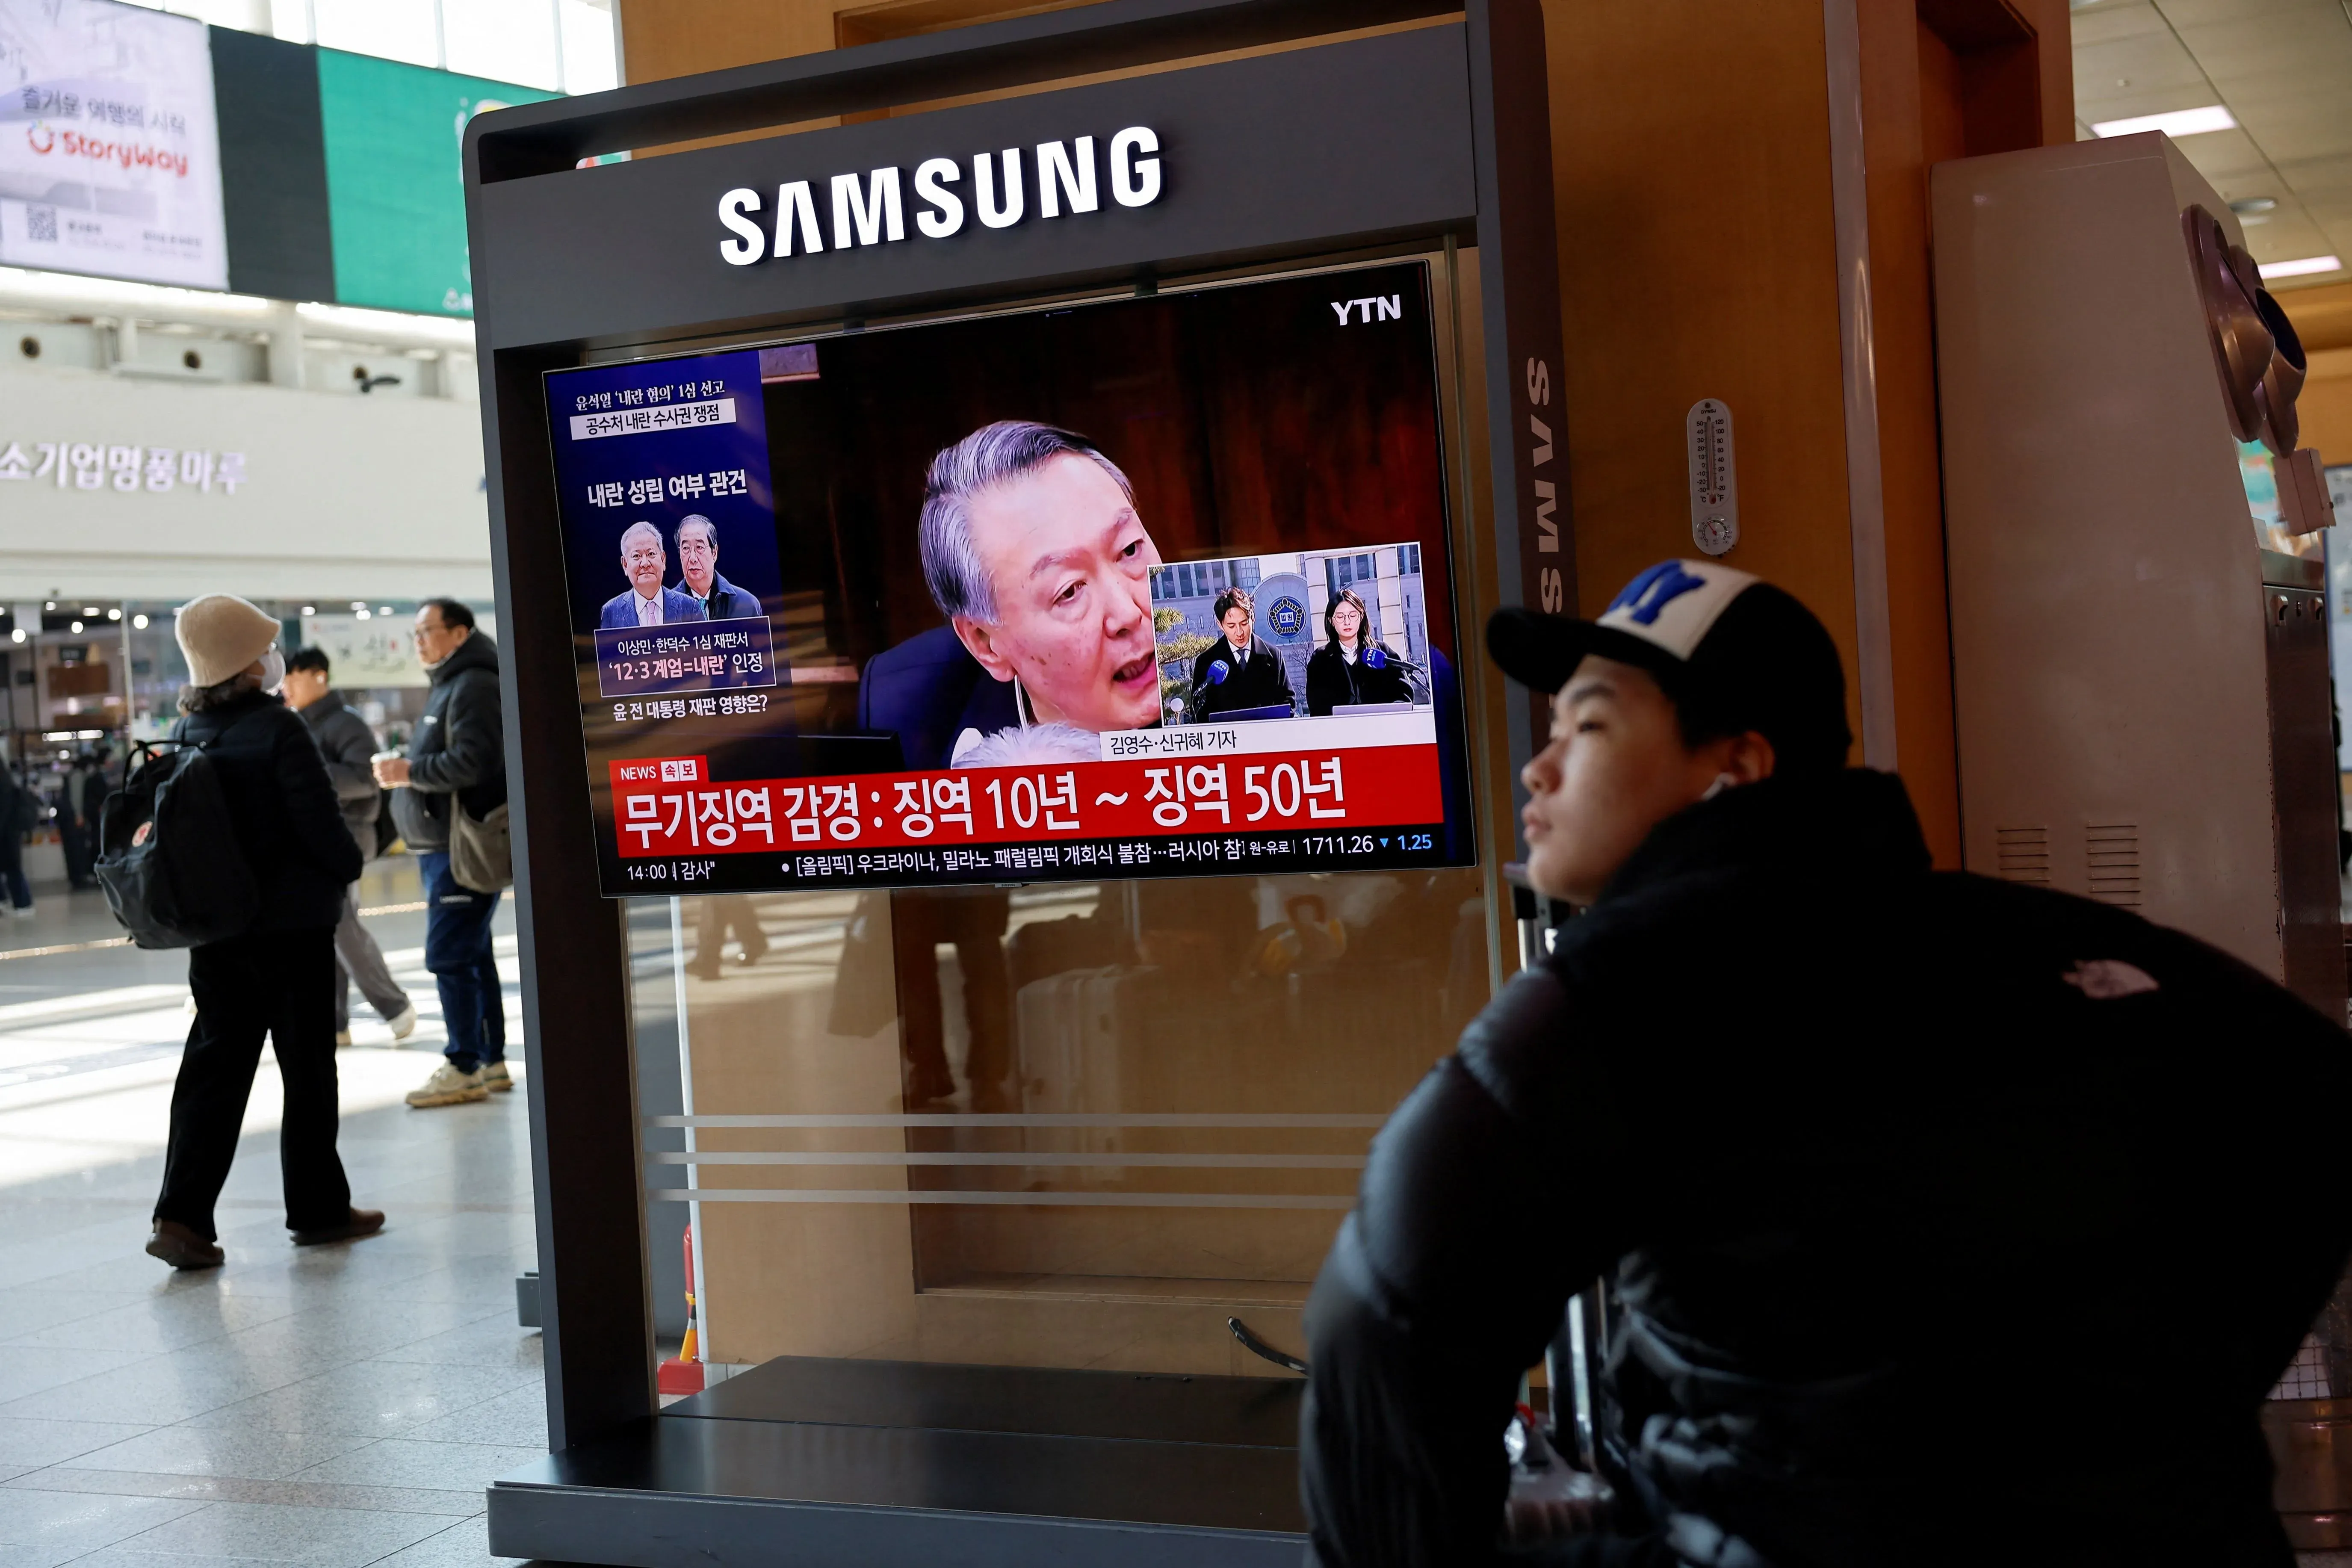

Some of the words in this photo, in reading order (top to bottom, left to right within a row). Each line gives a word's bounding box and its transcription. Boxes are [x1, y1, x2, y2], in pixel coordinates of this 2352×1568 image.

[719, 127, 1160, 265] SAMSUNG
[1331, 295, 1401, 325] YTN
[679, 382, 695, 398] 1심
[701, 381, 725, 396] 선고
[586, 415, 623, 435] 공수처
[626, 412, 650, 429] 내란
[654, 407, 691, 427] 수사권
[694, 404, 719, 422] 쟁점
[588, 482, 623, 507] 내란
[628, 478, 663, 504] 성립
[669, 474, 706, 499] 여부
[709, 470, 747, 496] 관건
[693, 635, 711, 650] 1심
[714, 632, 748, 648] 재판서
[733, 652, 762, 673] 인정
[614, 704, 627, 721] 윤
[630, 703, 643, 720] 전
[646, 700, 686, 718] 대통령
[689, 697, 716, 716] 재판
[719, 694, 767, 714] 영향은?
[1111, 732, 1203, 754] 김영수·신귀혜
[1208, 730, 1236, 749] 기자
[621, 766, 656, 780] NEWS
[665, 762, 694, 780] 속보
[626, 787, 774, 848] 무기징역
[894, 777, 973, 837] 징역
[986, 771, 1079, 830] 10년
[1144, 763, 1230, 826] 징역
[1245, 757, 1345, 821] 50년
[1250, 841, 1290, 855] 원-유로
[1303, 836, 1373, 854] 1711.26
[1398, 835, 1431, 850] 1.25
[796, 855, 853, 877] [올림픽]
[857, 852, 939, 873] 우크라이나,
[943, 850, 991, 870] 밀라노
[994, 847, 1058, 868] 패럴림픽
[1064, 845, 1112, 865] 개회식
[1223, 839, 1244, 860] 참
[628, 865, 666, 880] 14:00
